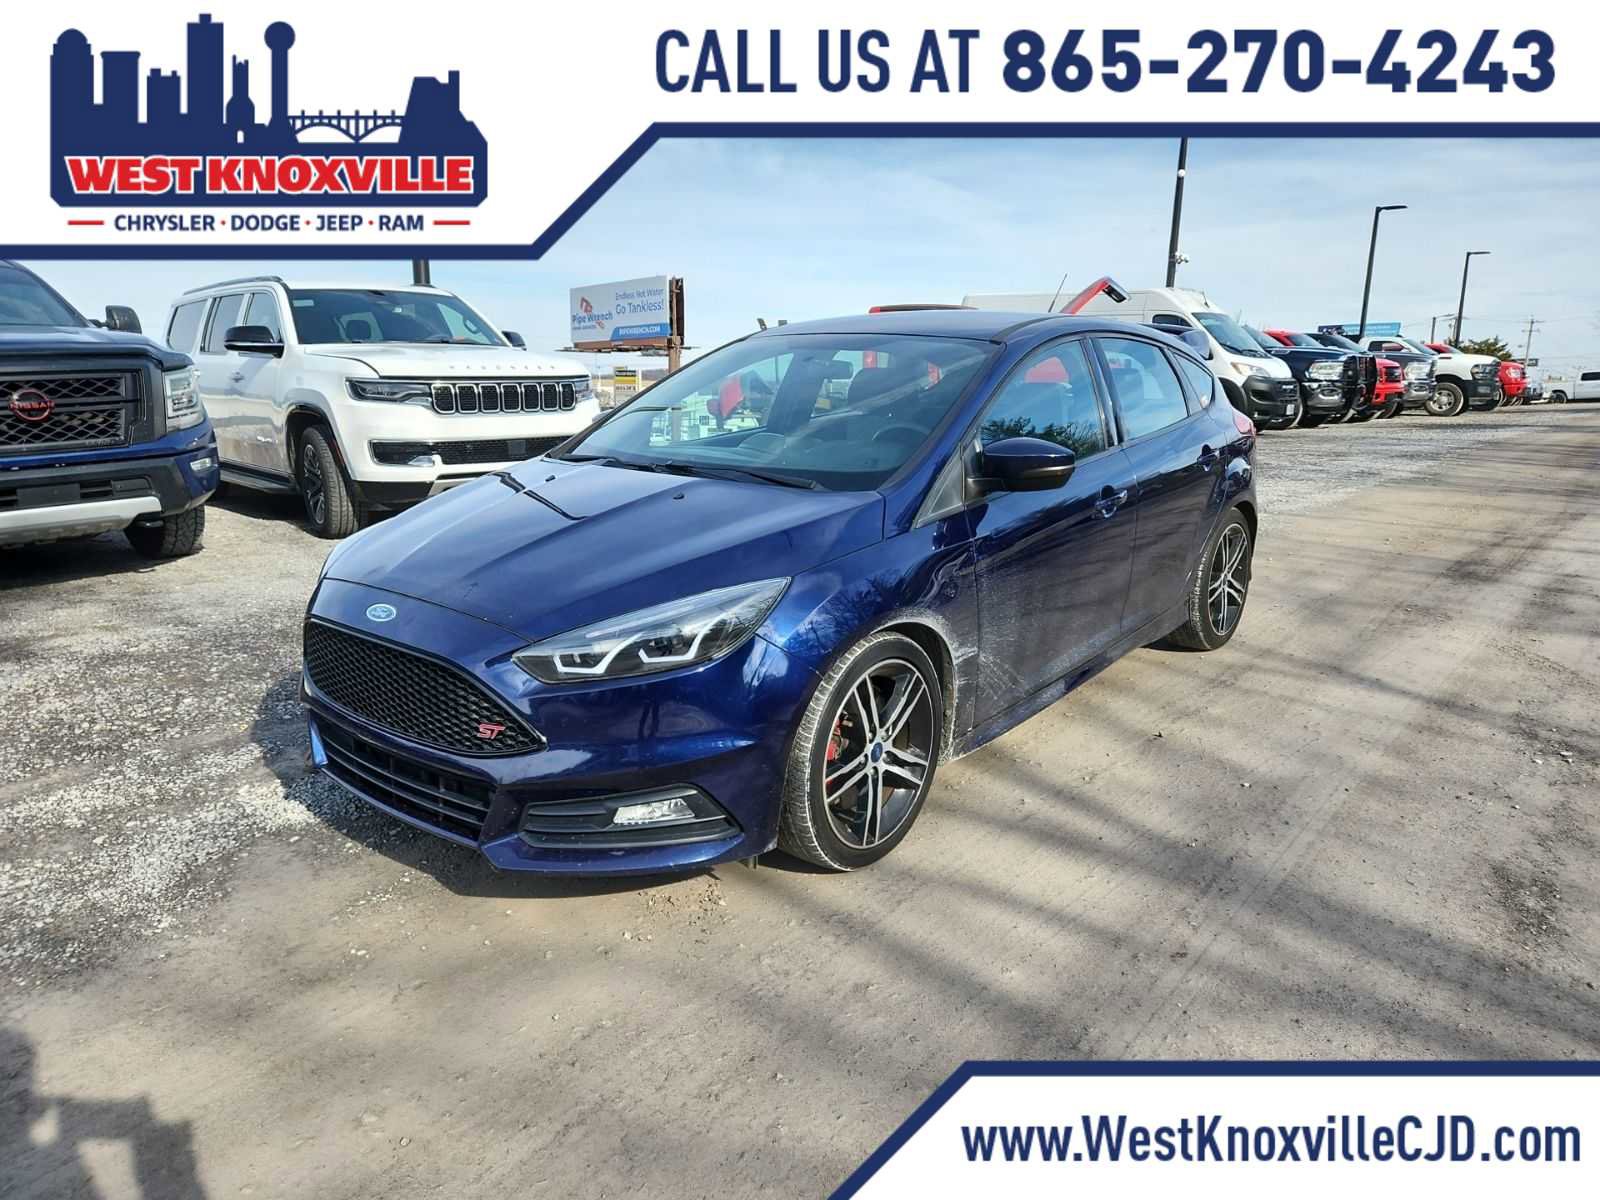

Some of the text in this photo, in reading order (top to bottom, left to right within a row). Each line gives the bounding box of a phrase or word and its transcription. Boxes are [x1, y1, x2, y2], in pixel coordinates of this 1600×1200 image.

[615, 299, 664, 314] Go Tankless!
[572, 311, 613, 324] Pipe Wrench
[477, 723, 506, 739] ST
